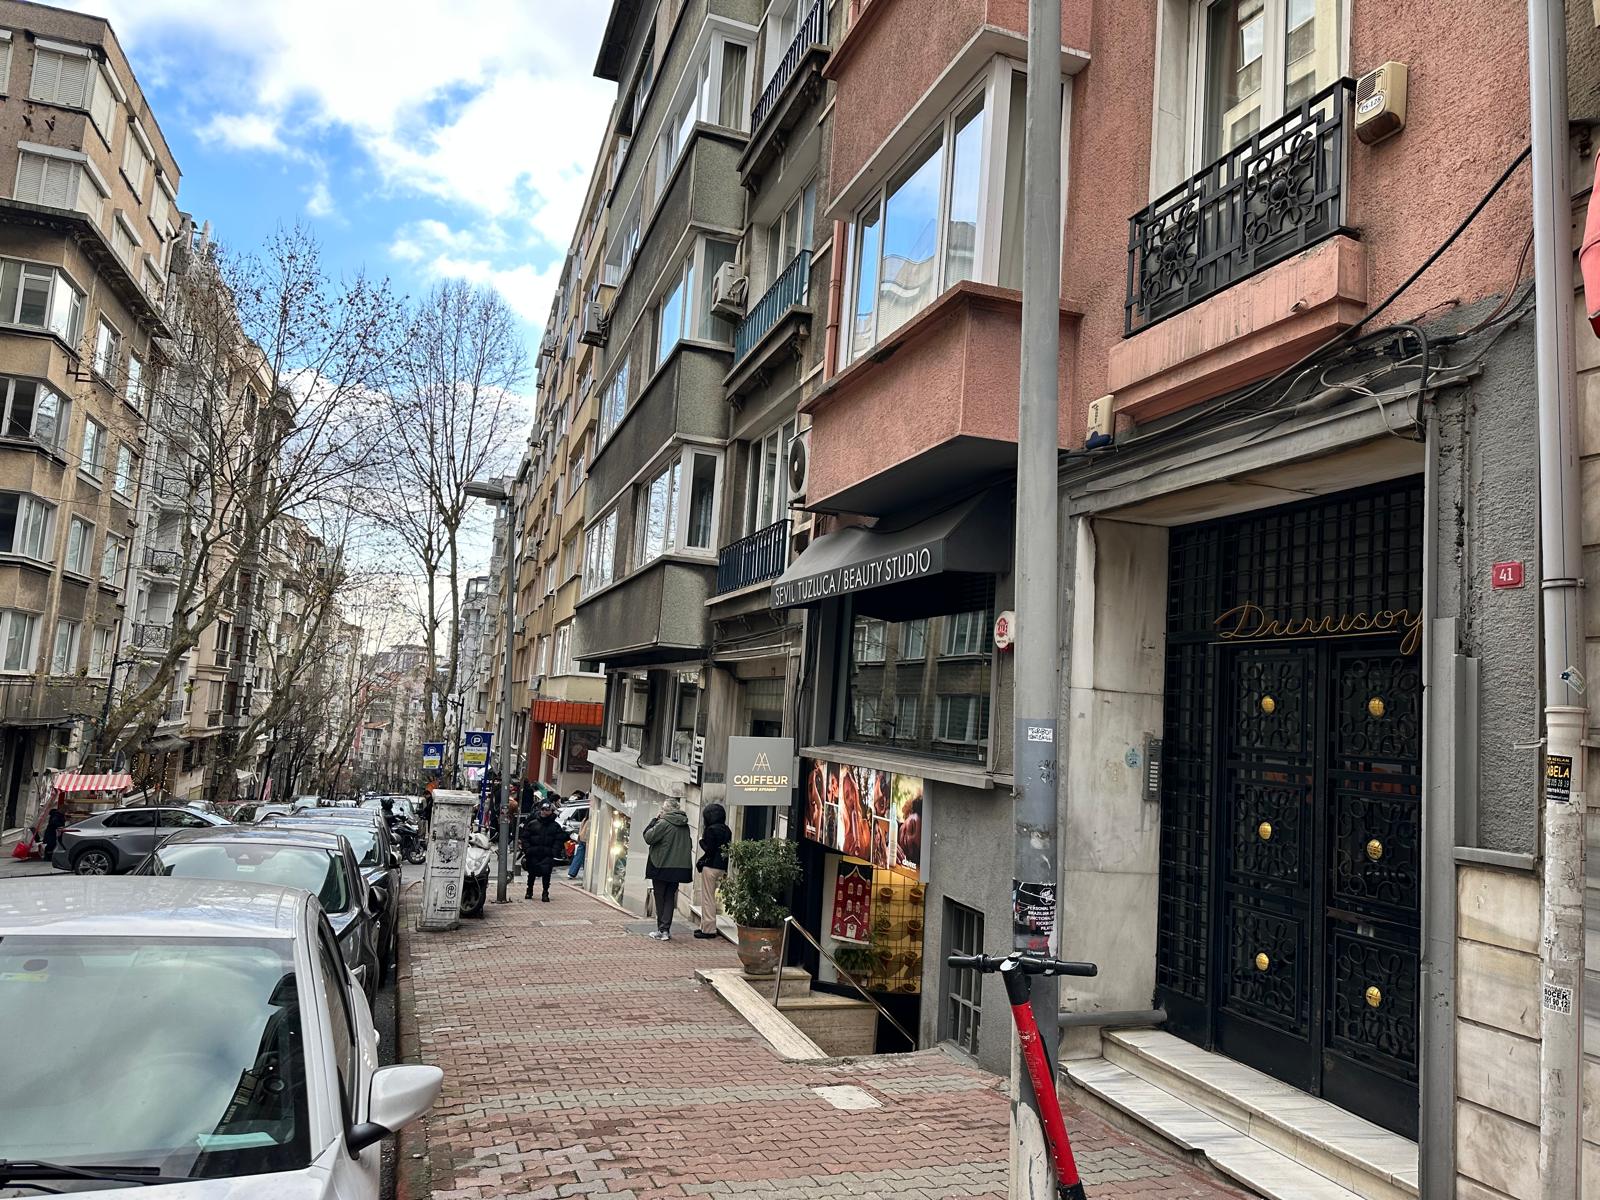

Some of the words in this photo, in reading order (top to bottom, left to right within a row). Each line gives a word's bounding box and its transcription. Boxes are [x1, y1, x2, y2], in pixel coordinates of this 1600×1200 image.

[797, 573, 836, 601] TUZLUCA
[843, 560, 883, 590] BEAUTY
[885, 547, 931, 581] STUDIO
[1499, 567, 1514, 582] 41
[733, 775, 788, 785] COIFFEUR
